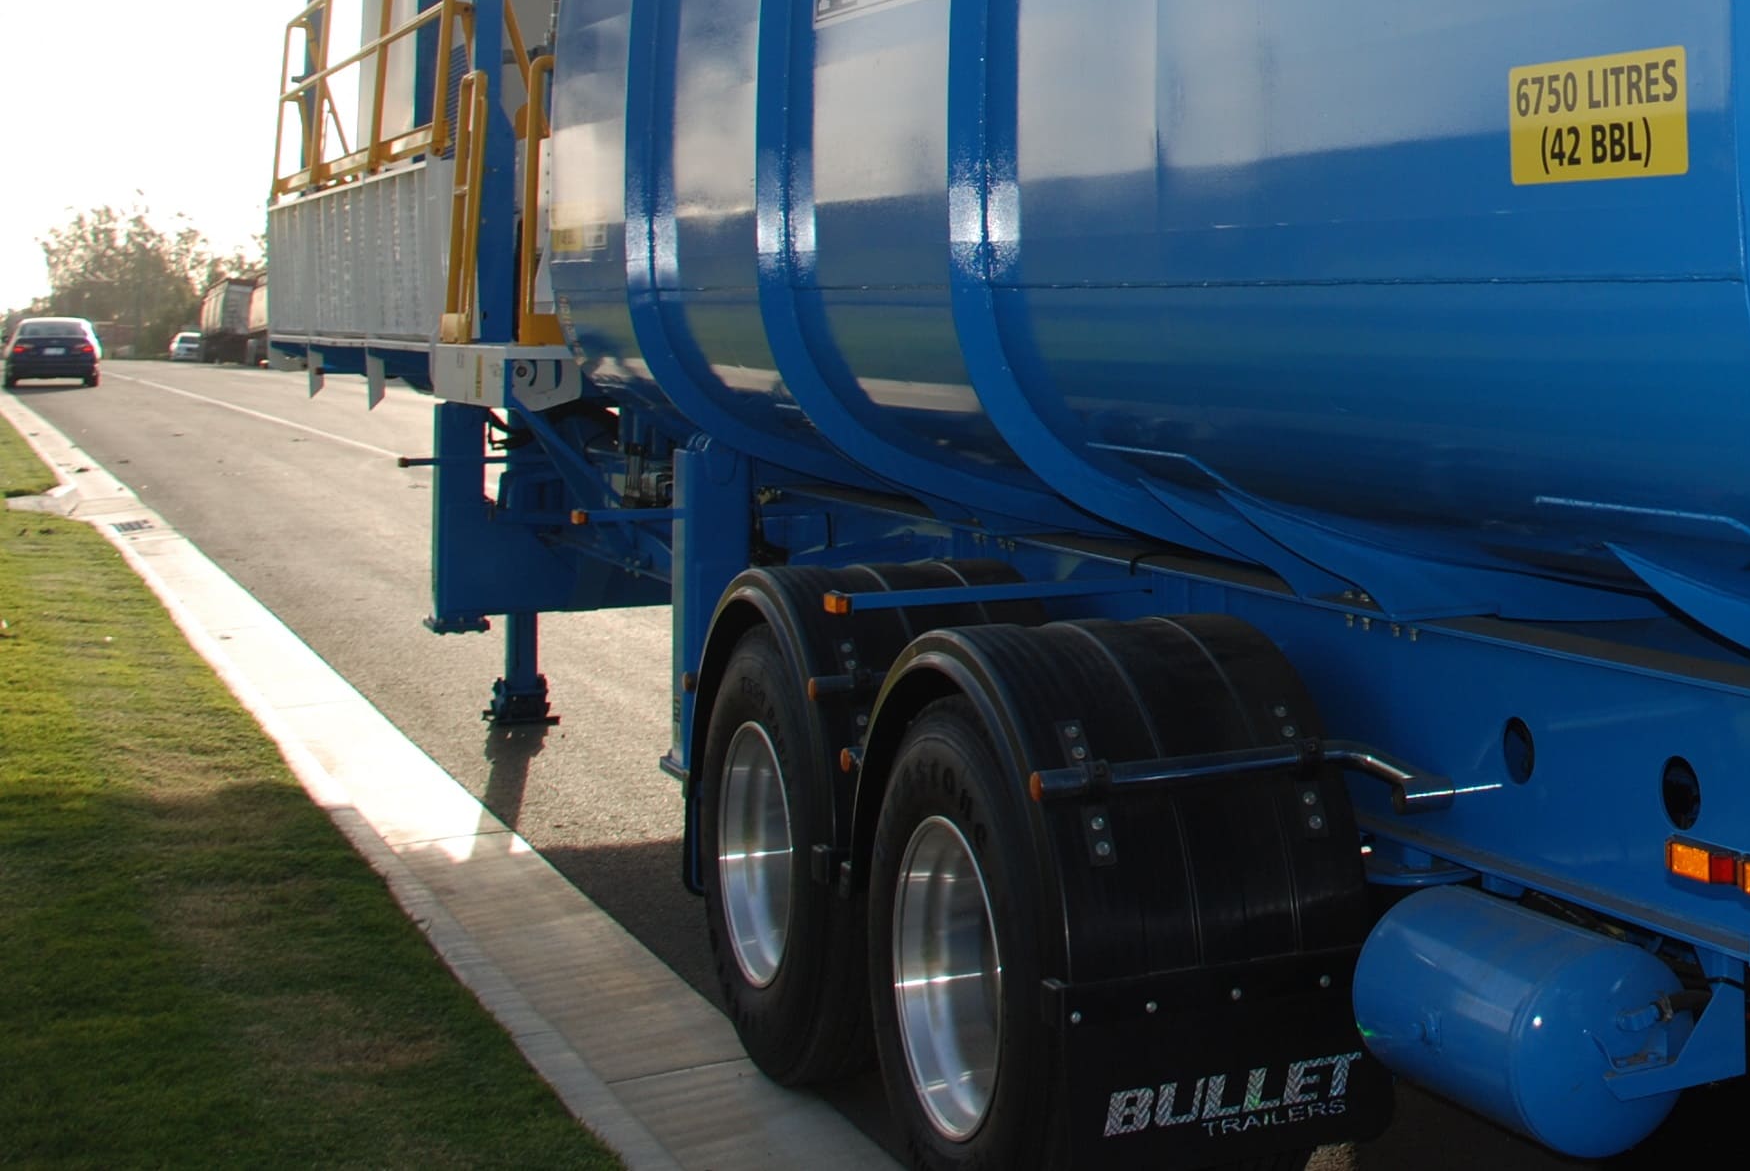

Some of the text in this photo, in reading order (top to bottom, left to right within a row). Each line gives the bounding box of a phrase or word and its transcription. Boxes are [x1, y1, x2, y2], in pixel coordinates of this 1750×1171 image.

[1516, 59, 1678, 117] 6750 LITRES
[1541, 117, 1652, 175] (42 BBL)
[1103, 1051, 1362, 1138] BULLET
[1202, 1099, 1347, 1137] TRAILERS
